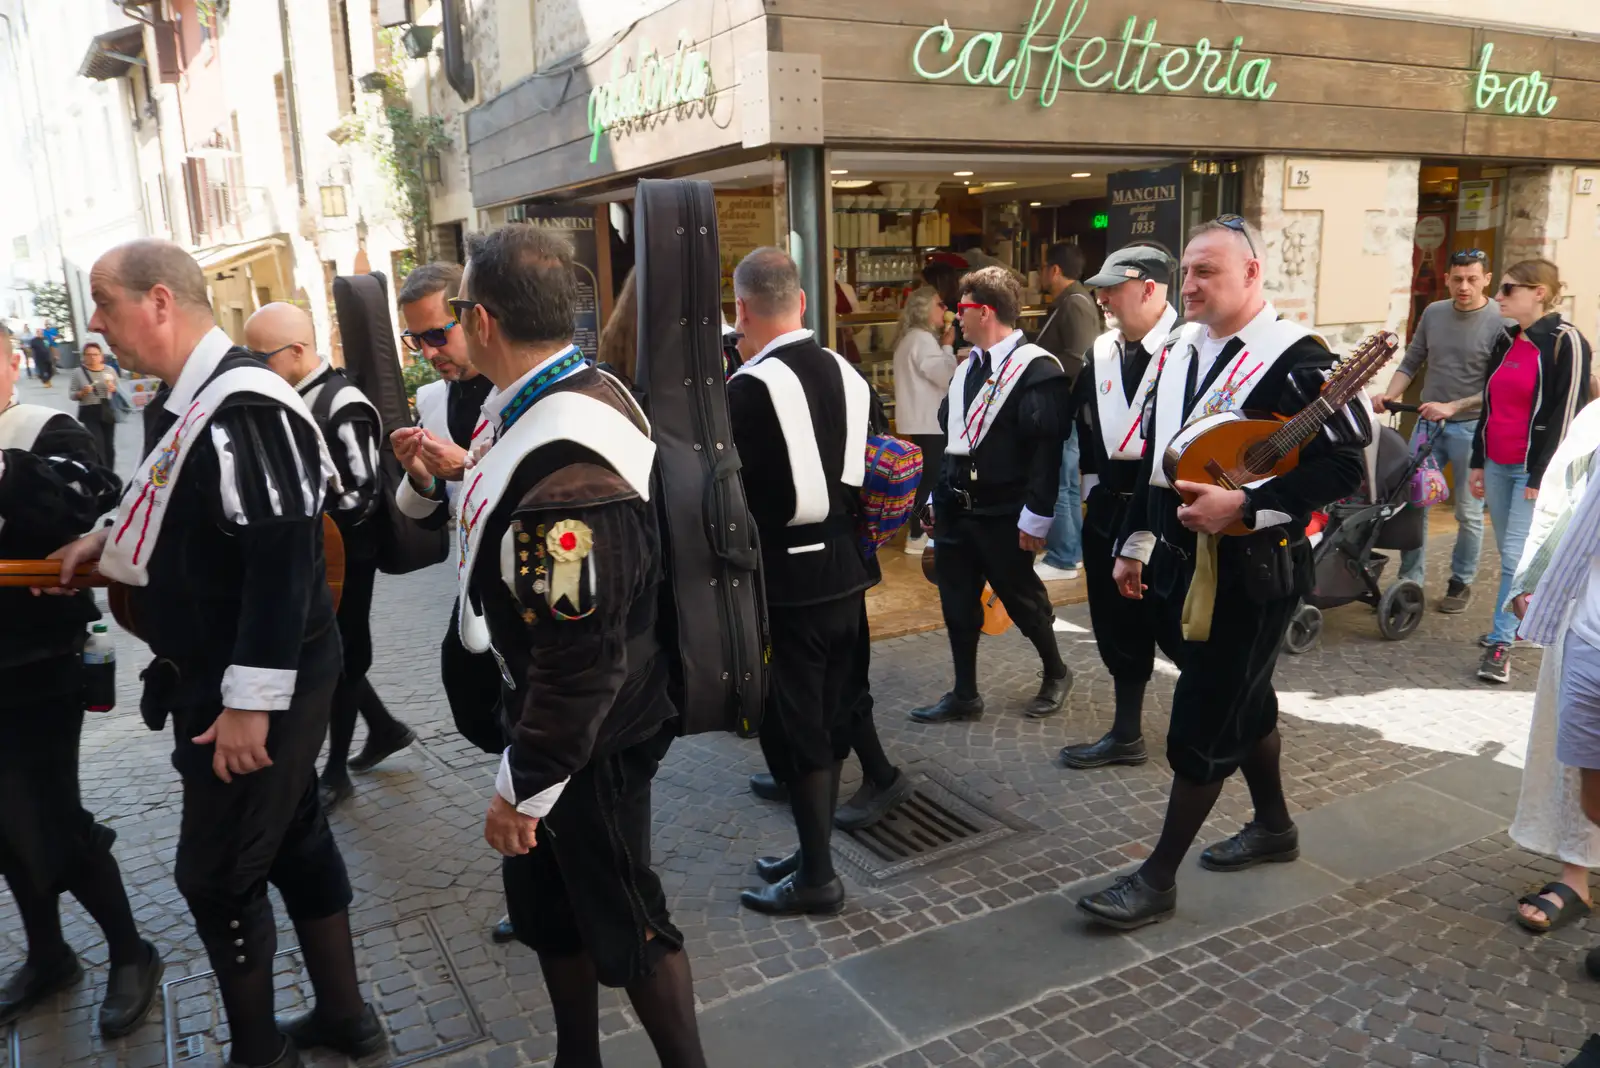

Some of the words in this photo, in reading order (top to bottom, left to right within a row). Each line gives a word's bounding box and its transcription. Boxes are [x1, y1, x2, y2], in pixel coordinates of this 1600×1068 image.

[912, 0, 1277, 108] caffetteria
[1475, 42, 1558, 115] bar
[1296, 169, 1310, 185] 25
[1583, 178, 1593, 191] 27
[1112, 184, 1176, 202] MANCINI
[527, 216, 594, 230] MANCINI
